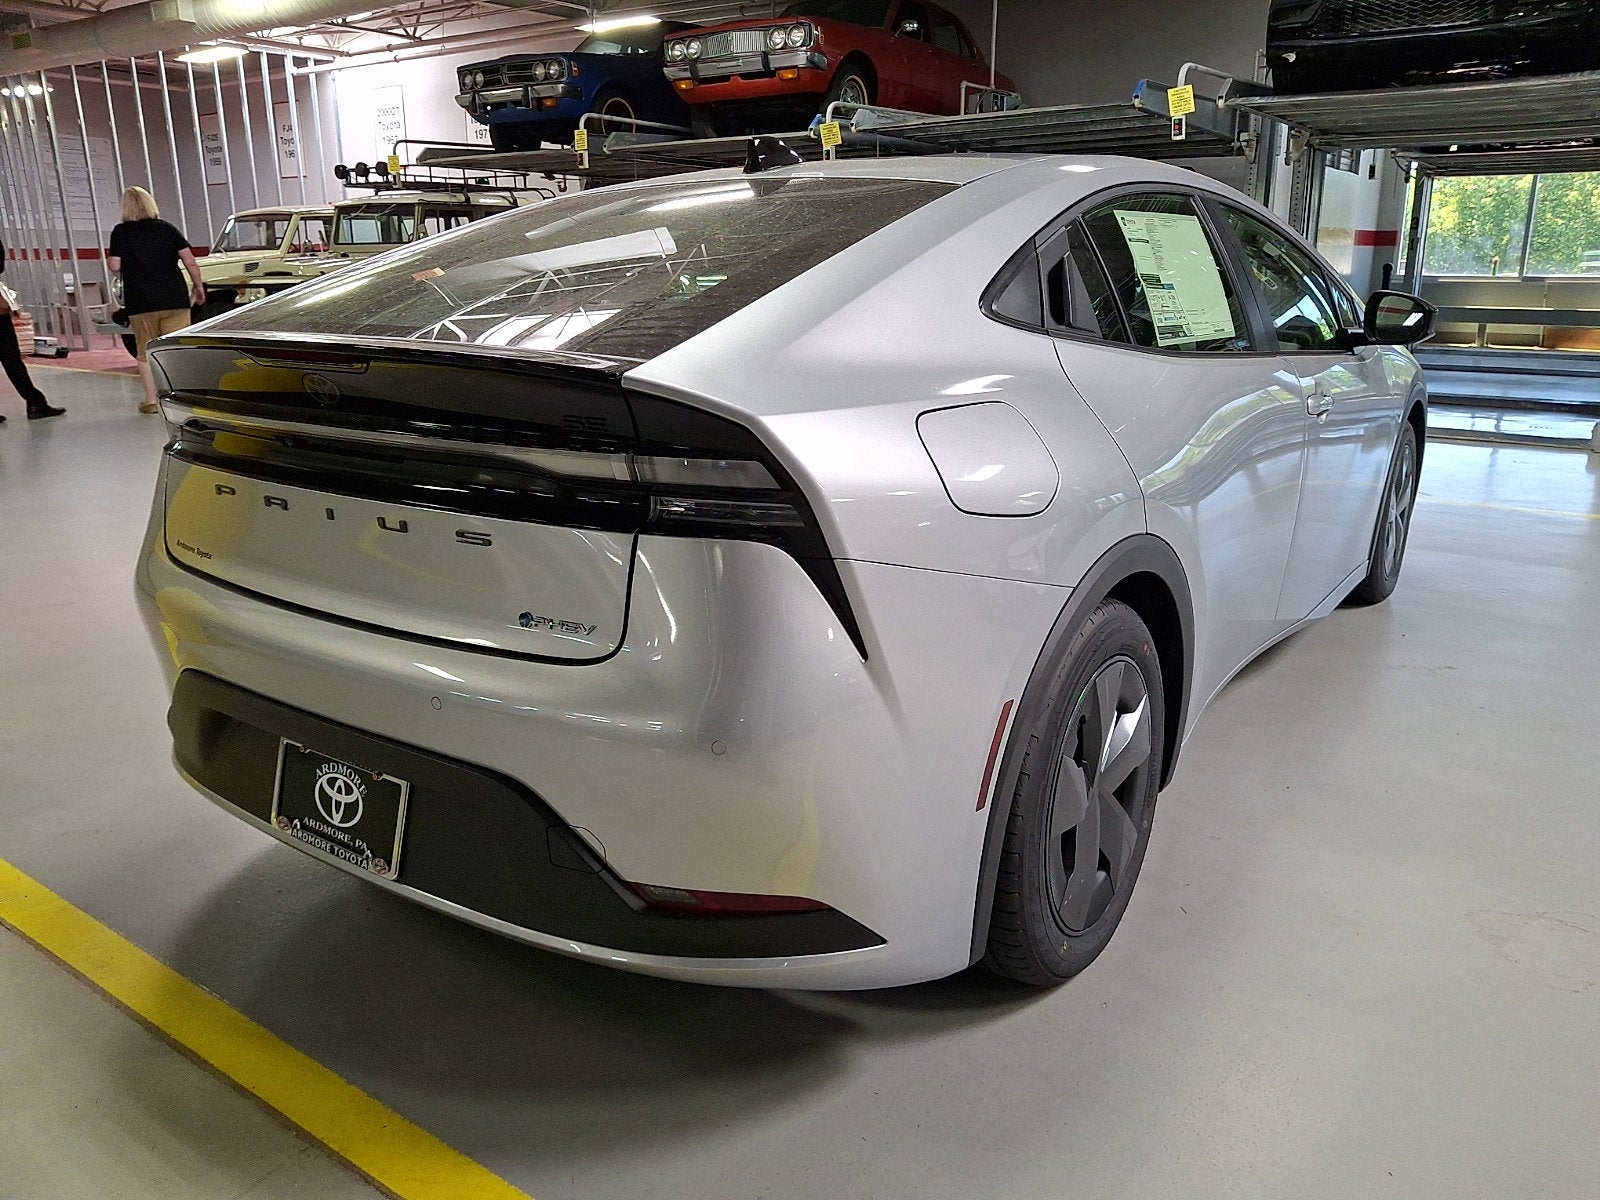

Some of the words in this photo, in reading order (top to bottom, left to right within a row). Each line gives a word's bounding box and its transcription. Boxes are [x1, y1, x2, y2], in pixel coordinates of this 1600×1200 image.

[282, 124, 293, 133] FJ4
[378, 121, 401, 132] Toyota
[474, 128, 488, 140] 197
[279, 136, 295, 147] Toyo
[284, 149, 296, 159] 196
[563, 414, 608, 431] SE
[214, 484, 493, 547] PRIUS
[532, 615, 598, 636] PHEV
[315, 762, 368, 798] ARDMORE
[303, 816, 354, 846] ARDMORE,
[291, 829, 332, 853] ARDMORE
[333, 845, 369, 870] TOYOTA
